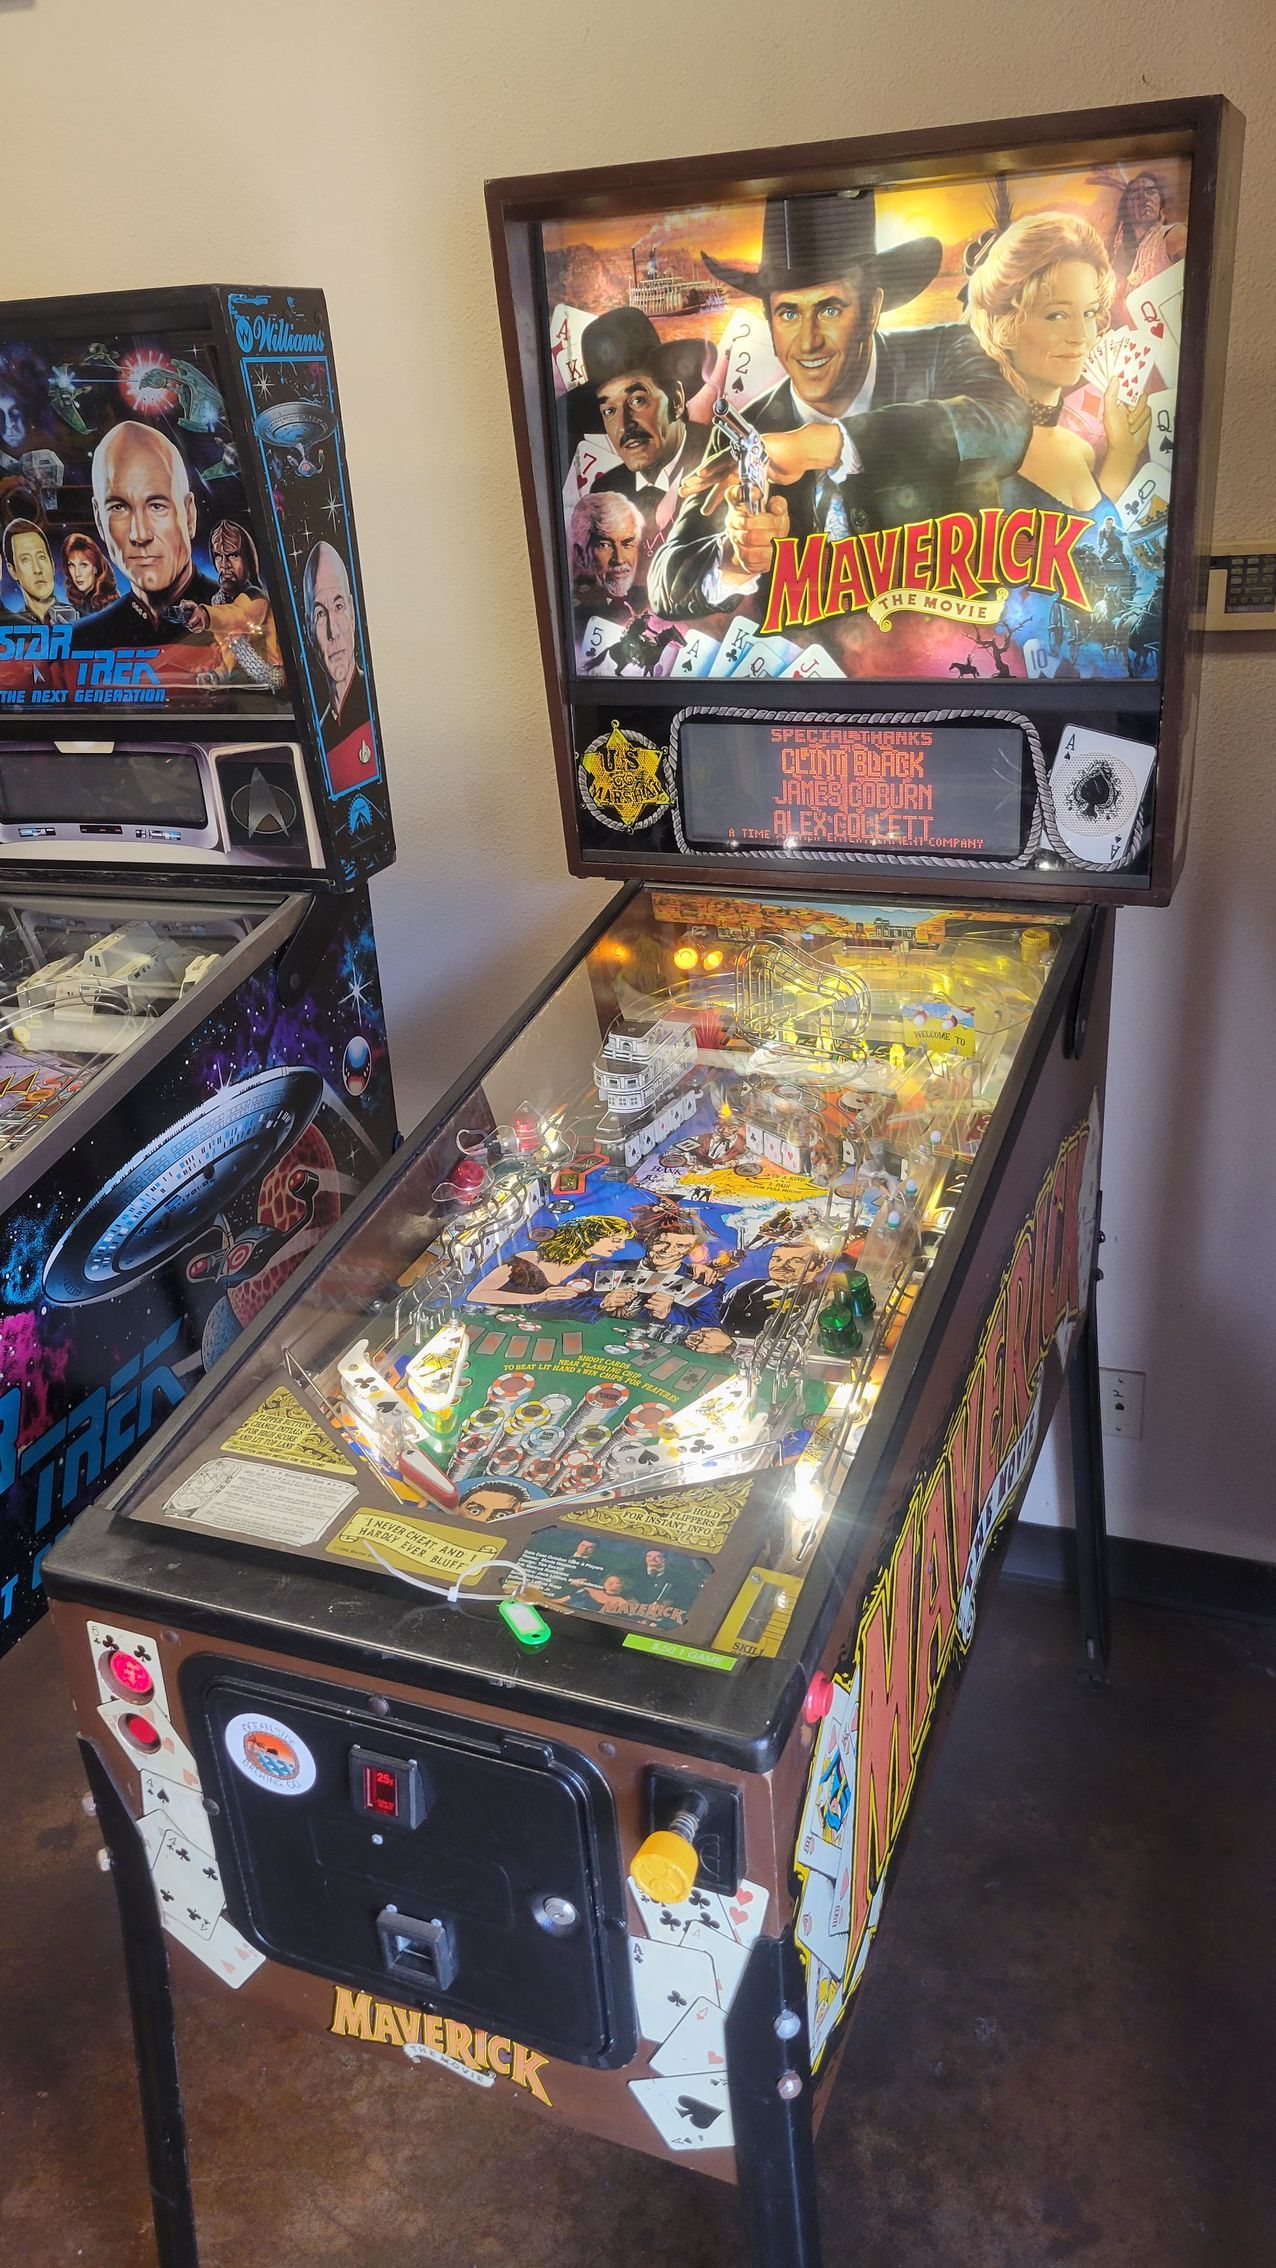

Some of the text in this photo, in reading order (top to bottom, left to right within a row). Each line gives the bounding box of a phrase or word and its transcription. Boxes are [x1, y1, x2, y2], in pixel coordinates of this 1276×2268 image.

[1141, 301, 1160, 322] Q
[253, 315, 325, 352] Williams
[556, 319, 568, 341] A
[565, 358, 582, 381] K
[736, 352, 751, 374] 2
[1157, 410, 1172, 432] Q
[582, 453, 597, 475] 7
[1138, 480, 1156, 504] Q
[759, 507, 1096, 635] MAVERICK
[879, 594, 987, 619] THE MOVIE
[0, 624, 73, 660] STAR
[590, 627, 604, 647] 5
[731, 628, 750, 650] K
[687, 640, 700, 659] A
[71, 649, 161, 685] TREK
[0, 689, 166, 703] THE NEXT GENERATION
[771, 728, 933, 746] SPECIAL THANKS
[1065, 733, 1076, 751] A
[782, 748, 924, 778] CLINT BLACK
[772, 780, 933, 810] JAMES COBURN
[773, 810, 828, 837] ALEX
[727, 828, 735, 837] A
[742, 828, 771, 839] TIME
[928, 837, 984, 849] COMPANY
[914, 1031, 966, 1047] WELCOME TO
[651, 1166, 682, 1175] BANK
[558, 1359, 642, 1379] NEAR FLASHING CHIP
[578, 1355, 631, 1370] SHOOT CARDS
[552, 1365, 576, 1373] HAND
[582, 1368, 597, 1377] WIN
[599, 1371, 623, 1382] CHIPS
[624, 1377, 641, 1386] FOR
[641, 1383, 680, 1403] FEATURES
[20, 1318, 188, 1535] TREK
[250, 1421, 305, 1435] CHANGE INITIALS
[257, 1414, 313, 1429] FLIPPER BUTTONS
[244, 1427, 299, 1442] FOR HIGH SCORE
[252, 1436, 264, 1444] LIT
[623, 1511, 711, 1535] FOR INSTANT INFO
[669, 1511, 716, 1527] FLIPPERS
[692, 1507, 720, 1519] HOLD
[359, 1527, 401, 1545] HARDLY
[400, 1541, 428, 1557] EVER
[375, 1520, 405, 1536] NEVER
[439, 1545, 466, 1559] AND
[848, 1115, 1092, 1990] MAVERICK
[599, 1602, 688, 1625] MAVERICK
[688, 1650, 724, 1665] GAME
[633, 1943, 644, 1956] A
[330, 1985, 553, 2108] MAVERICK
[410, 2045, 485, 2083] THE MOVIE
